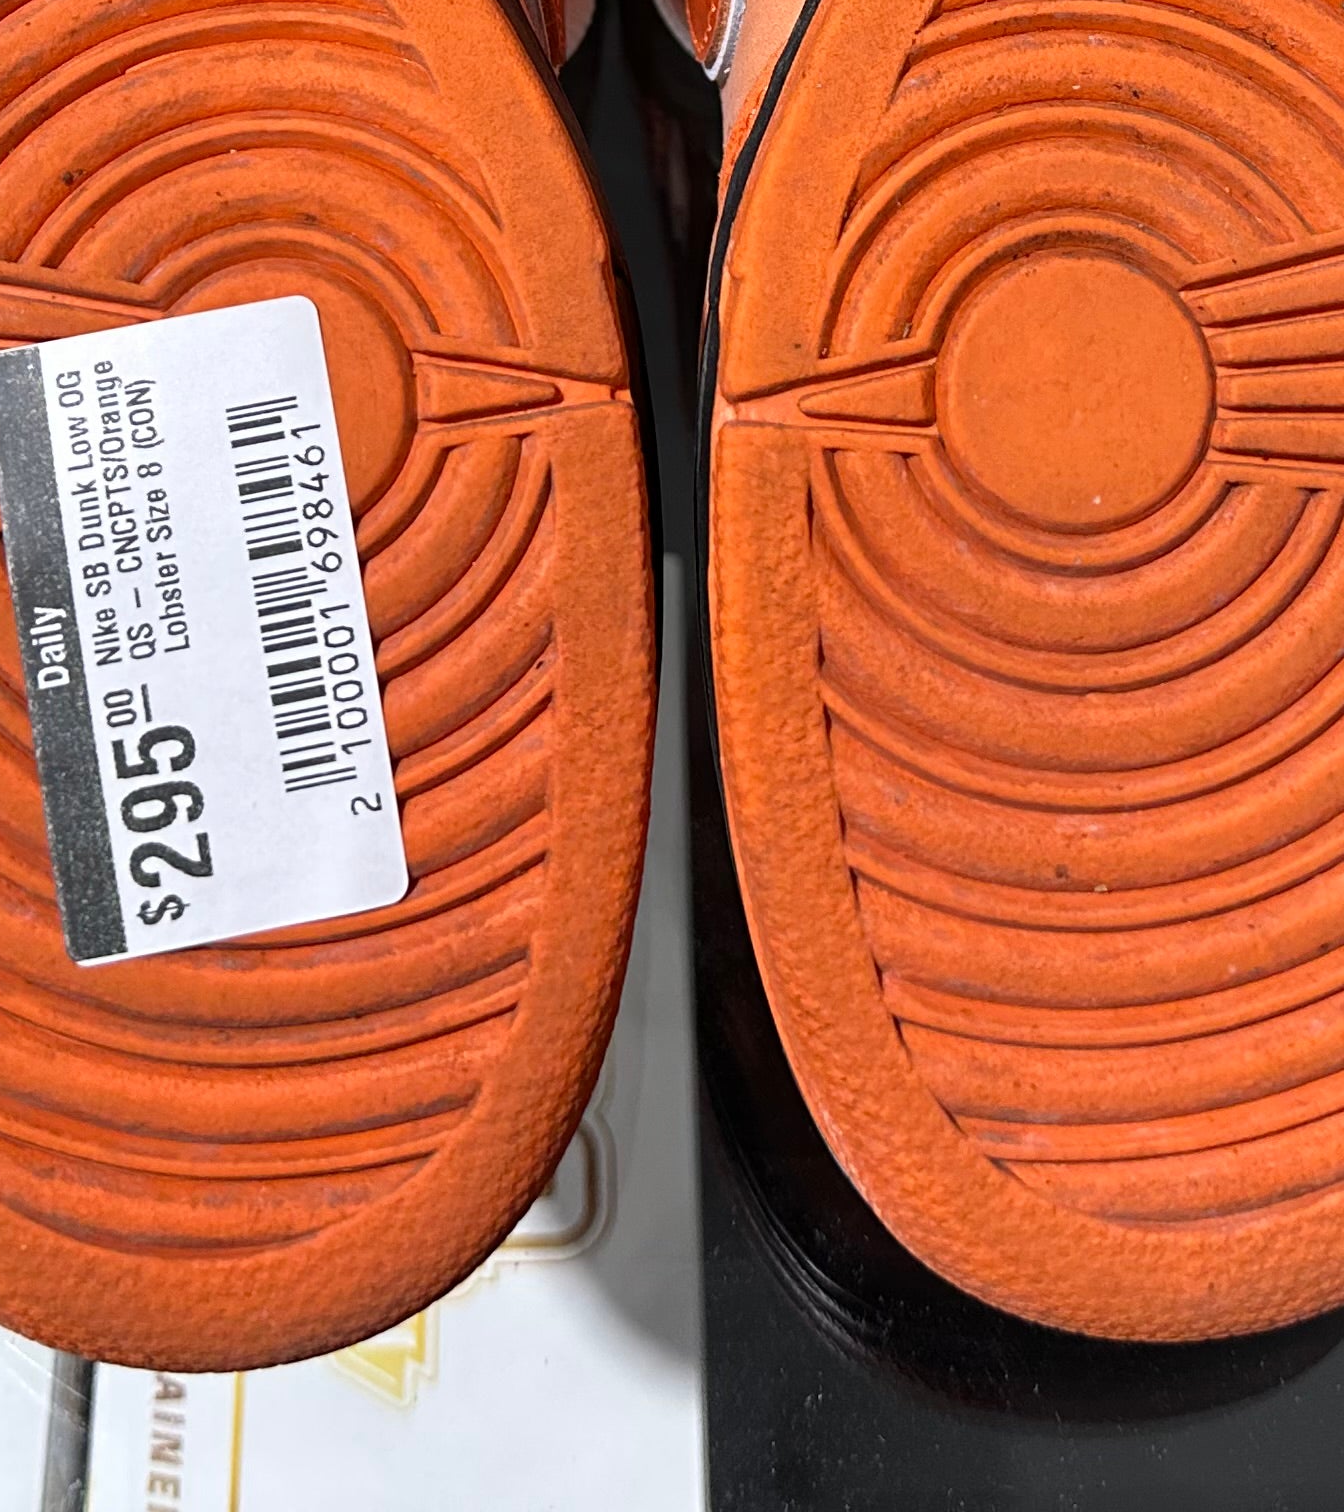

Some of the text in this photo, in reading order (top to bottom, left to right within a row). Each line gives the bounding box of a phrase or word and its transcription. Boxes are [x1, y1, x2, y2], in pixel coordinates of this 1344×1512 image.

[56, 370, 123, 666] Nike SB Dunk Low OG
[94, 360, 143, 573] CNCPTS/Orange
[123, 379, 191, 654] Lobster Size 8 (CON)
[29, 606, 71, 689] Daily
[126, 622, 156, 660] QS
[289, 423, 383, 816] 2 100001 698461
[147, 1374, 187, 1512] AINE
